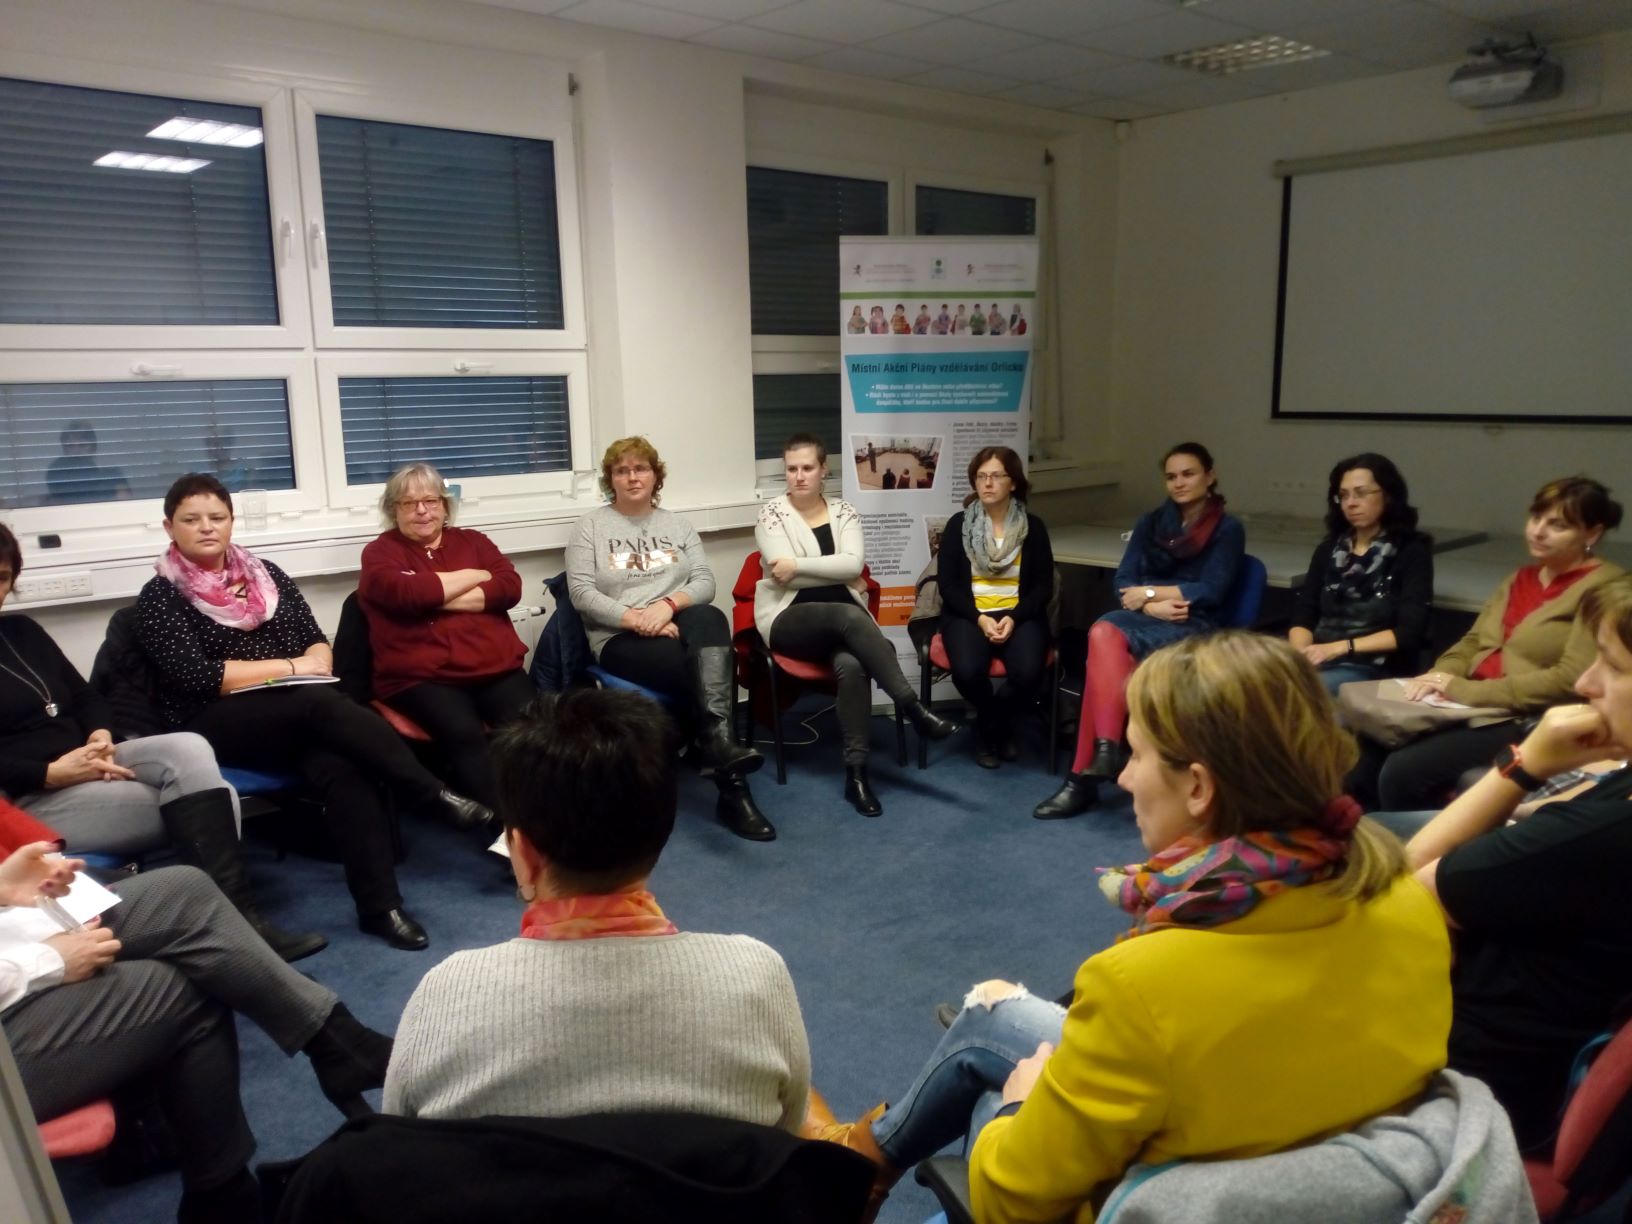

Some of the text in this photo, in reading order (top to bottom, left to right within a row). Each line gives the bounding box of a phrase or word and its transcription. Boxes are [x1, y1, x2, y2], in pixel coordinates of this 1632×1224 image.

[851, 362, 880, 373] Místní
[884, 362, 908, 373] Akční
[911, 362, 936, 374] Plány
[608, 536, 672, 553] PARIS
